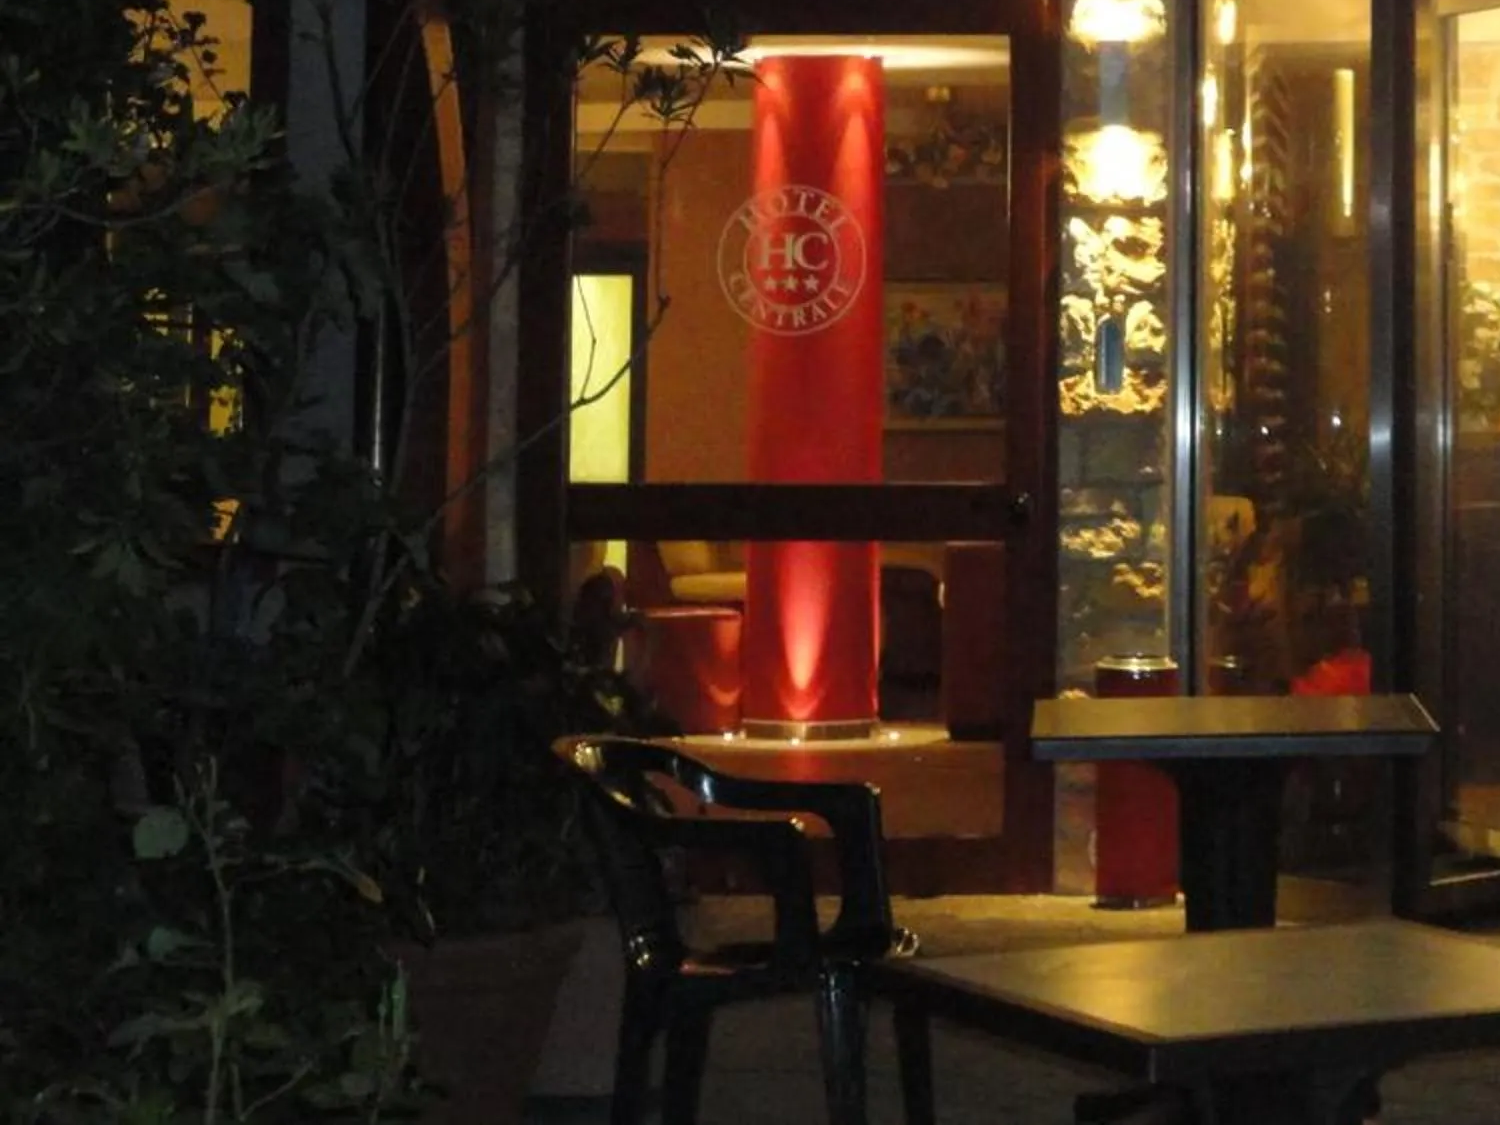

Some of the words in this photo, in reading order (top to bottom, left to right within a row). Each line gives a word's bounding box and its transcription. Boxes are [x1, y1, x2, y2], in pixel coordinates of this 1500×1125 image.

[737, 189, 850, 232] HOTEL
[758, 232, 830, 271] HC
[729, 271, 851, 328] CENTRALE
